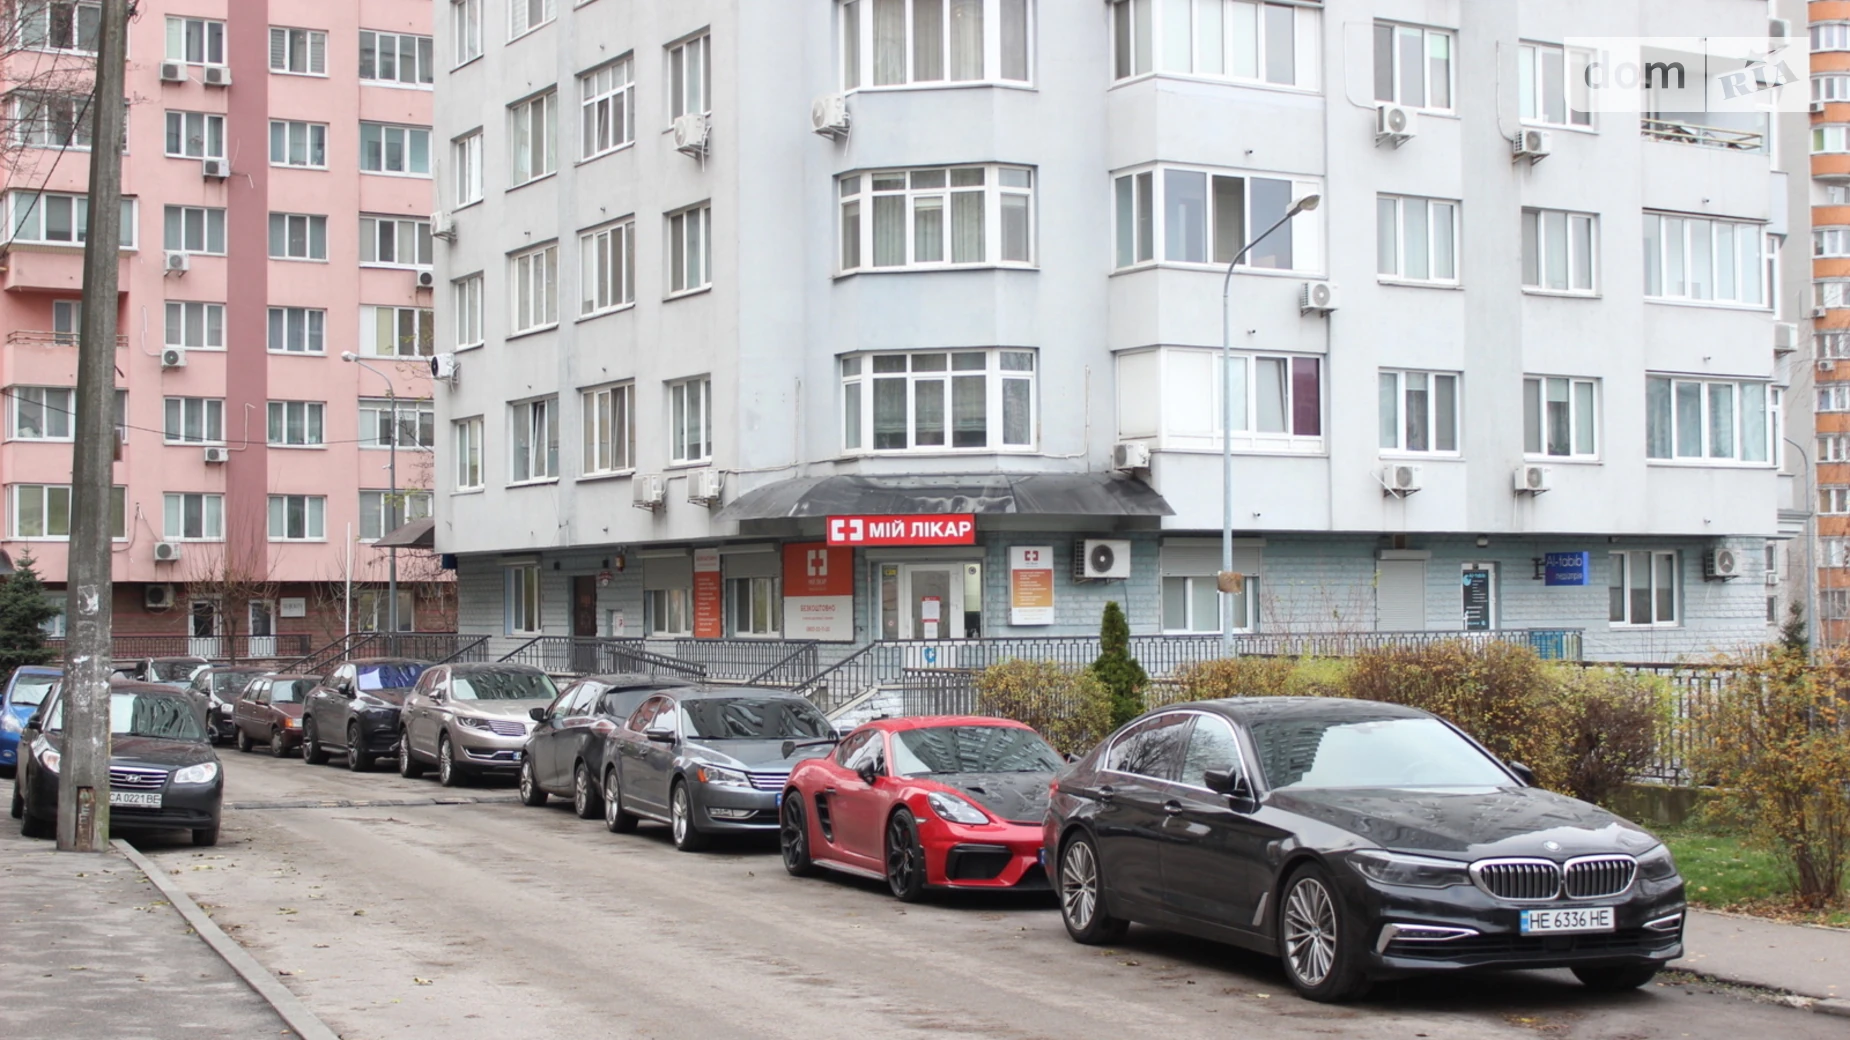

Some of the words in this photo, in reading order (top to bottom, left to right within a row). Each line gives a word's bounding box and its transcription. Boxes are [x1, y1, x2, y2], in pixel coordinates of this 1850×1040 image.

[869, 520, 905, 538] МІЙ
[910, 521, 971, 538] ЛІКАР
[124, 794, 145, 803] 0221
[146, 794, 160, 803] BE
[1530, 913, 1551, 929] HE
[1554, 912, 1587, 928] 6336
[1590, 910, 1609, 926] HE
